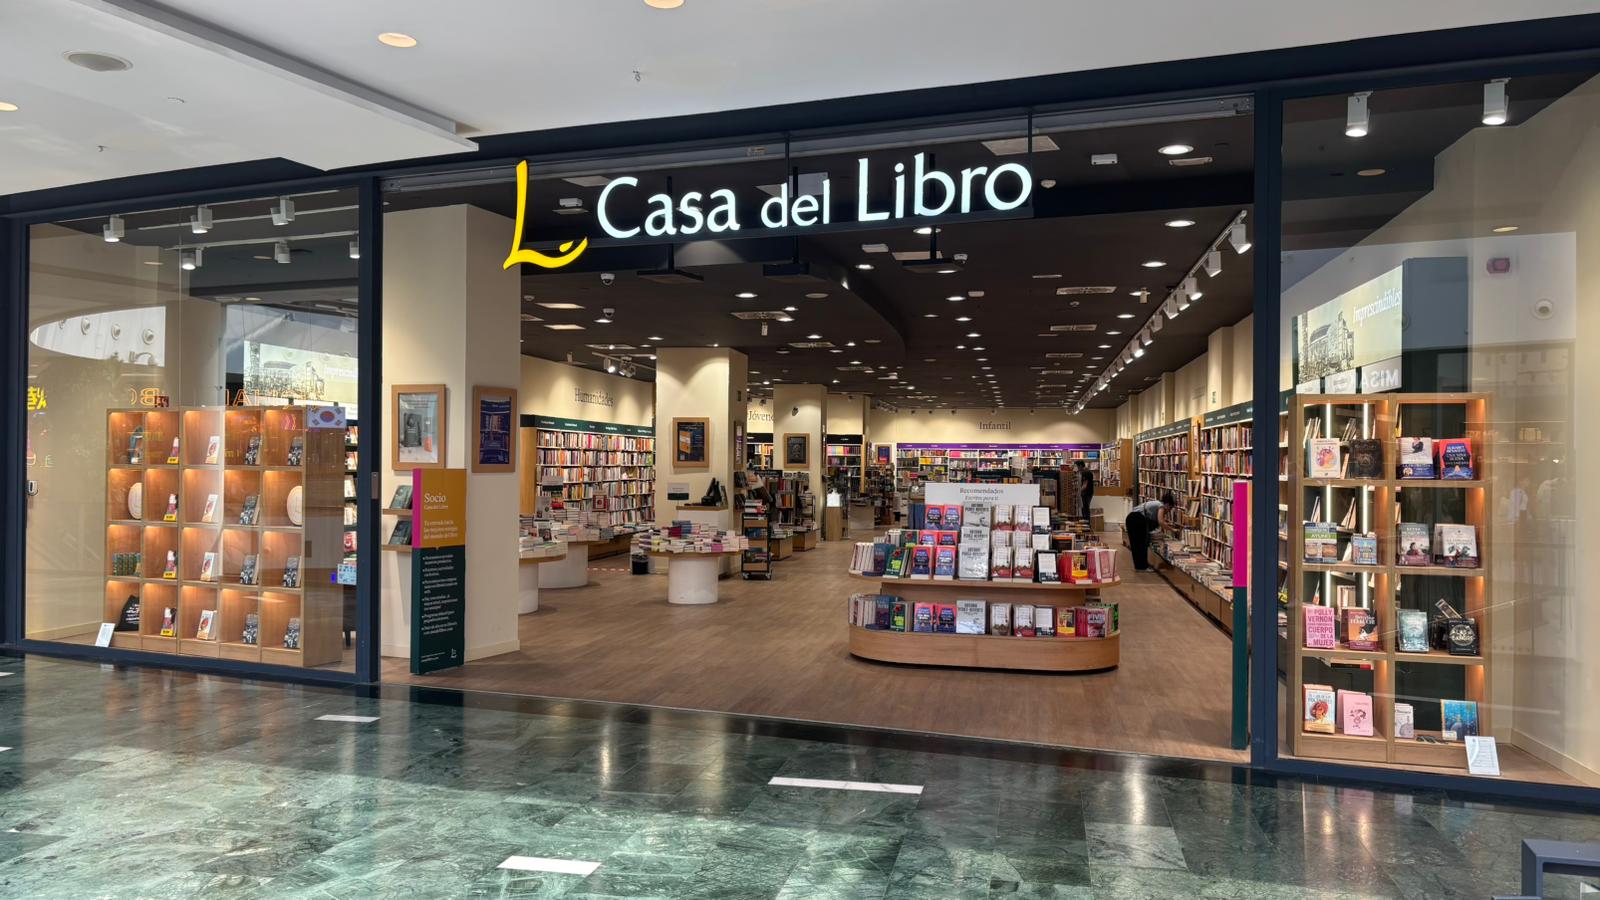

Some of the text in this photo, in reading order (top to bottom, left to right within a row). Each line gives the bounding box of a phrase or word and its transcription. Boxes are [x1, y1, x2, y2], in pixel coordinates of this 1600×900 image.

[597, 152, 1032, 238] Casa del Libro
[574, 387, 614, 407] Humanidades
[748, 410, 774, 421] Jóvene
[979, 420, 1012, 430] Infantil
[959, 487, 1004, 495] Recomendados
[423, 492, 447, 503] Socio
[1314, 639, 1334, 647] MUJER
